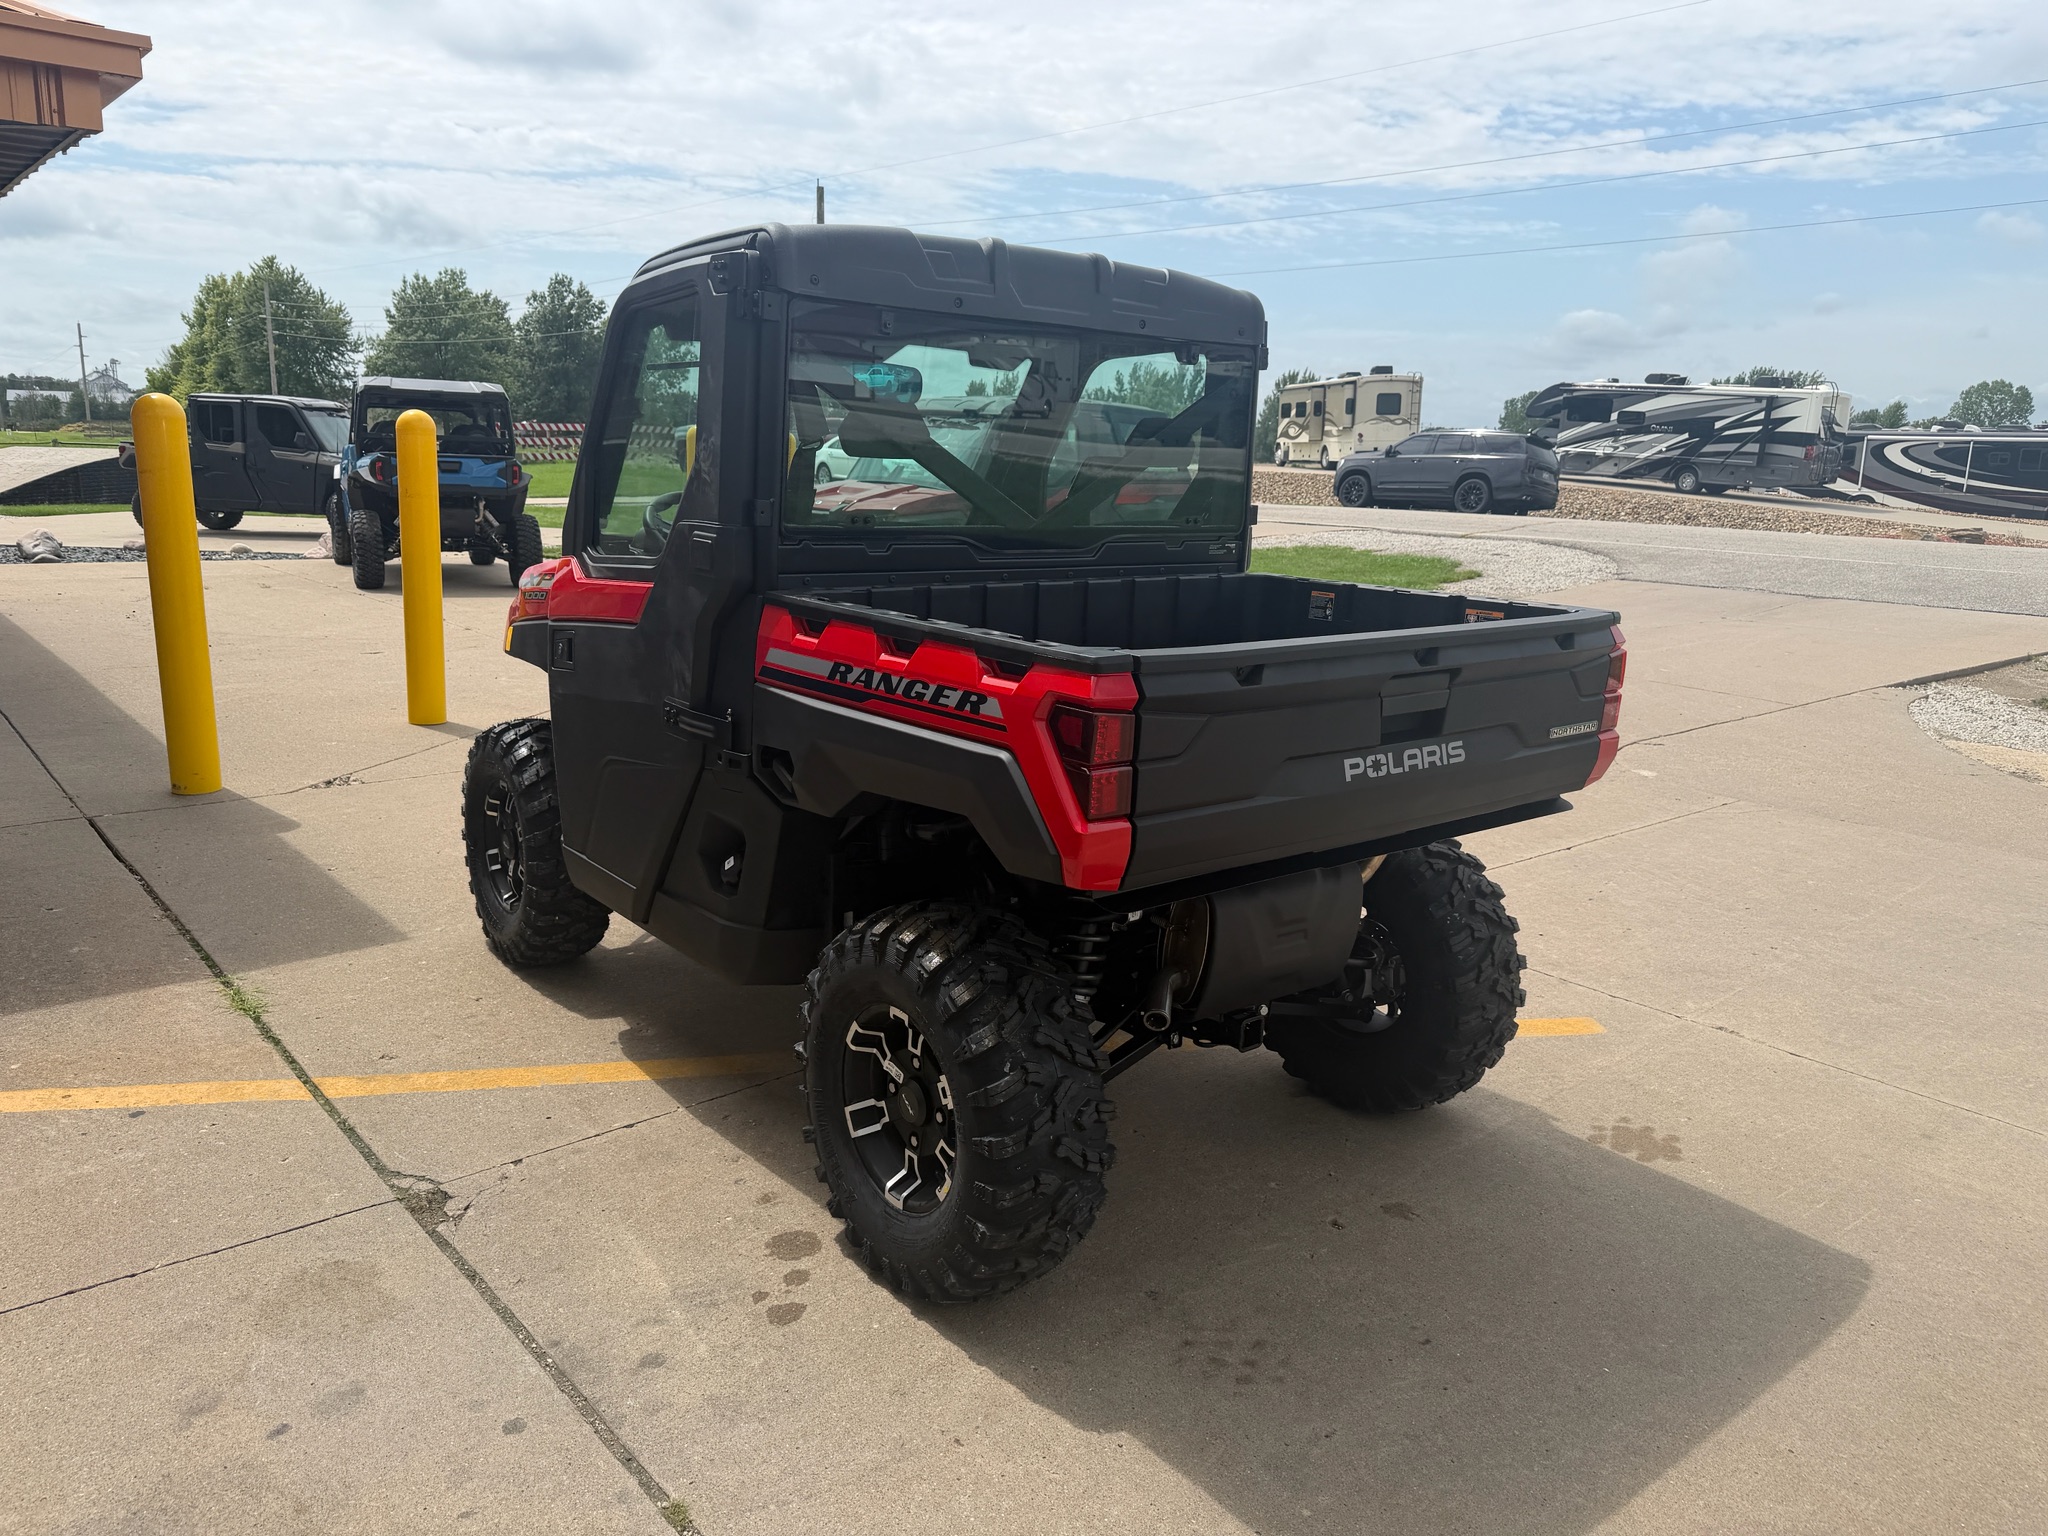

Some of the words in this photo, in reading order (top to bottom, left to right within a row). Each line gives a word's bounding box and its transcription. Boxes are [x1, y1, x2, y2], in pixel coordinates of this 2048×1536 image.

[523, 572, 556, 587] XP
[525, 591, 547, 600] 1000
[827, 661, 988, 716] RANGER
[1552, 722, 1598, 737] NORTHSTAR
[1343, 740, 1466, 782] POLARIS
